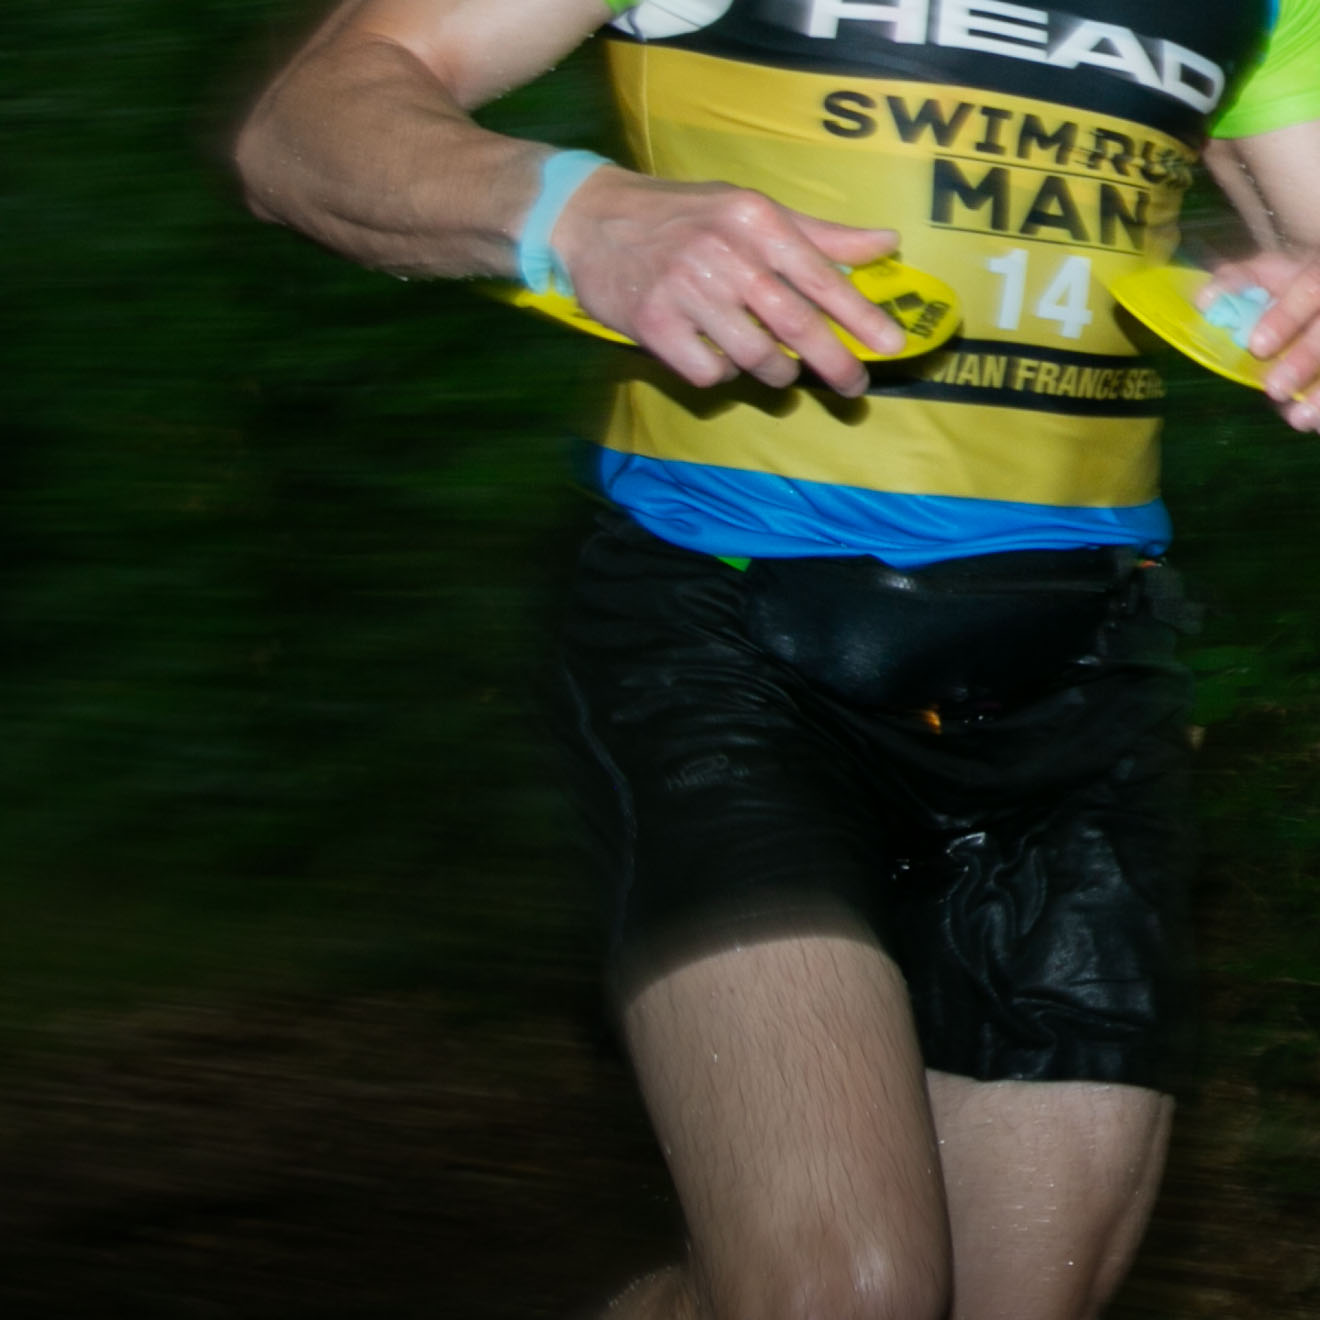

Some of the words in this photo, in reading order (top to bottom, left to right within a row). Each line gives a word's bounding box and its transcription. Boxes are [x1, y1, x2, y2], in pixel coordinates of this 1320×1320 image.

[931, 158, 1150, 251] MAN
[986, 248, 1092, 340] 14
[1014, 358, 1120, 400] FRANCE
